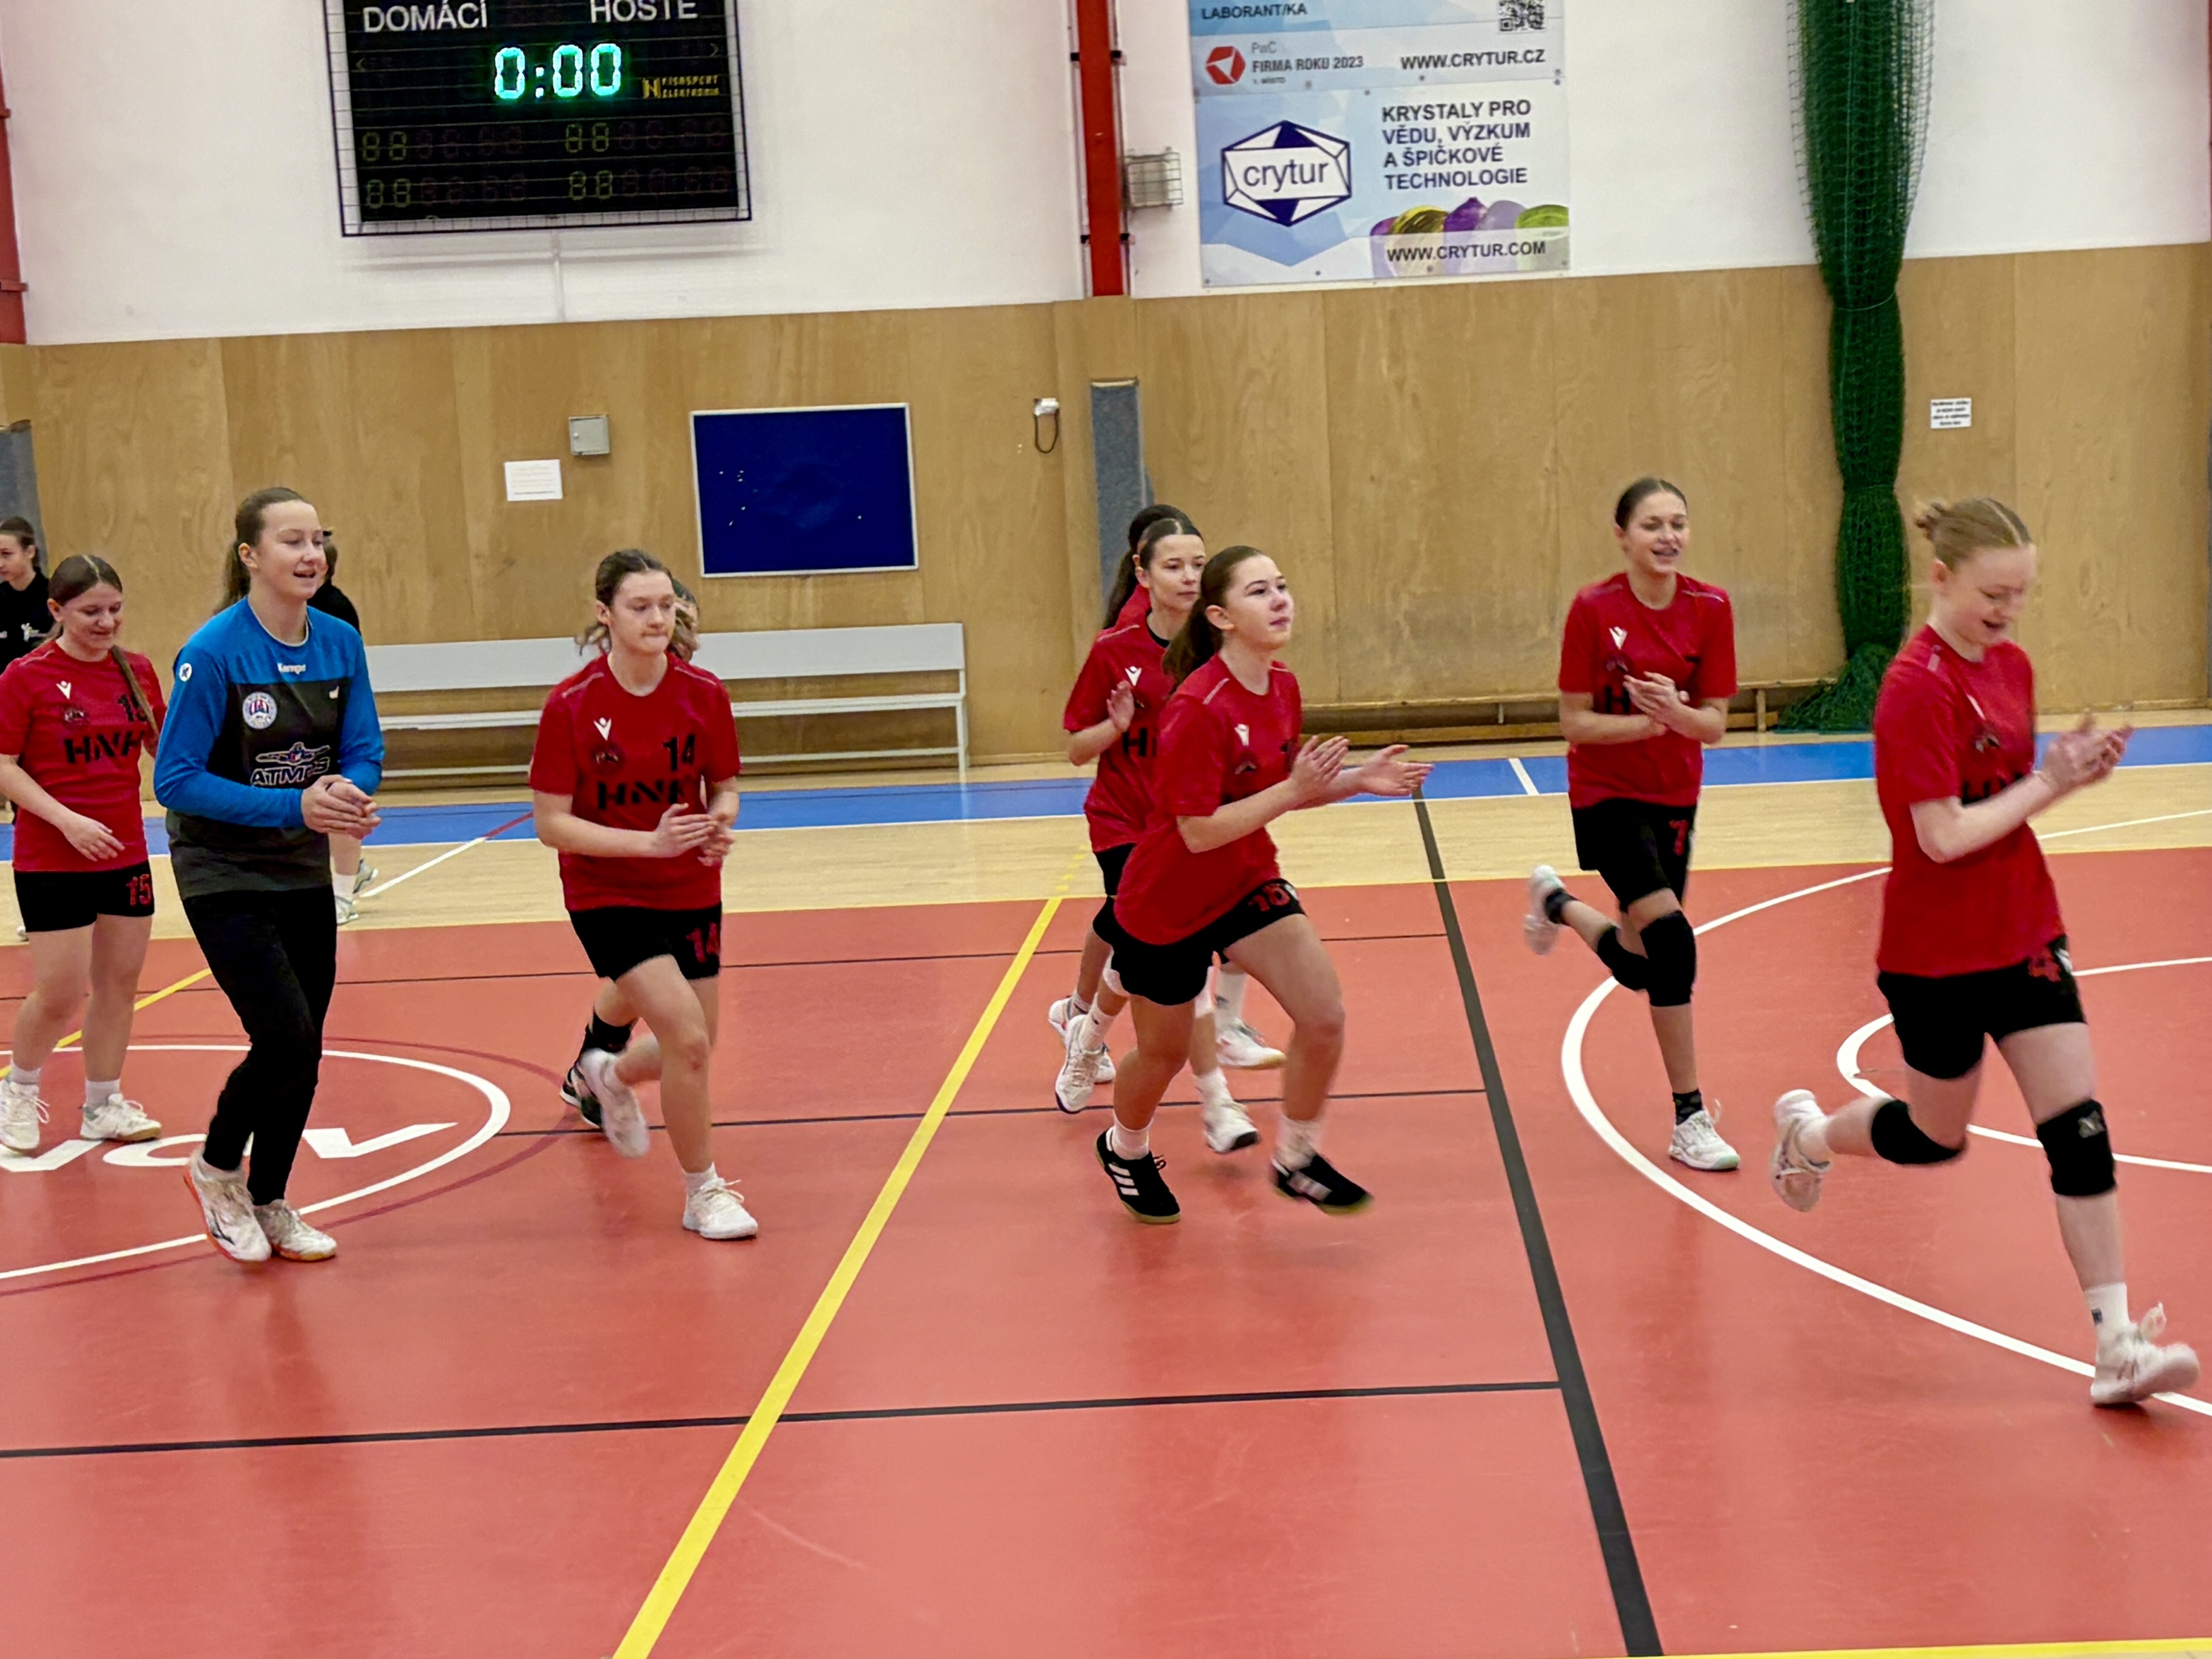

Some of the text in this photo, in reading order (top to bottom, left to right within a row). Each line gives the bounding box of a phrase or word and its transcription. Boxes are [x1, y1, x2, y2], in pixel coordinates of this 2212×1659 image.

[1202, 3, 1307, 19] LABORANT/KA
[1252, 56, 1363, 73] FIRMA ROKU 2023
[1401, 49, 1546, 69] WWW.CRYTUR.CZ
[494, 43, 621, 100] 0:00
[1382, 100, 1531, 122] KRYSTALY PRO
[1382, 121, 1530, 144] VĚDU, VÝZKUM
[1383, 142, 1503, 167] A ŠPIČKOVÉ
[1243, 158, 1329, 192] crytur
[1384, 168, 1528, 190] TECHNOLOGIE
[1387, 242, 1546, 261] WWW.CRYTUR.COM
[663, 734, 695, 771] 14
[1668, 819, 1689, 856] 7
[126, 874, 151, 905] 15
